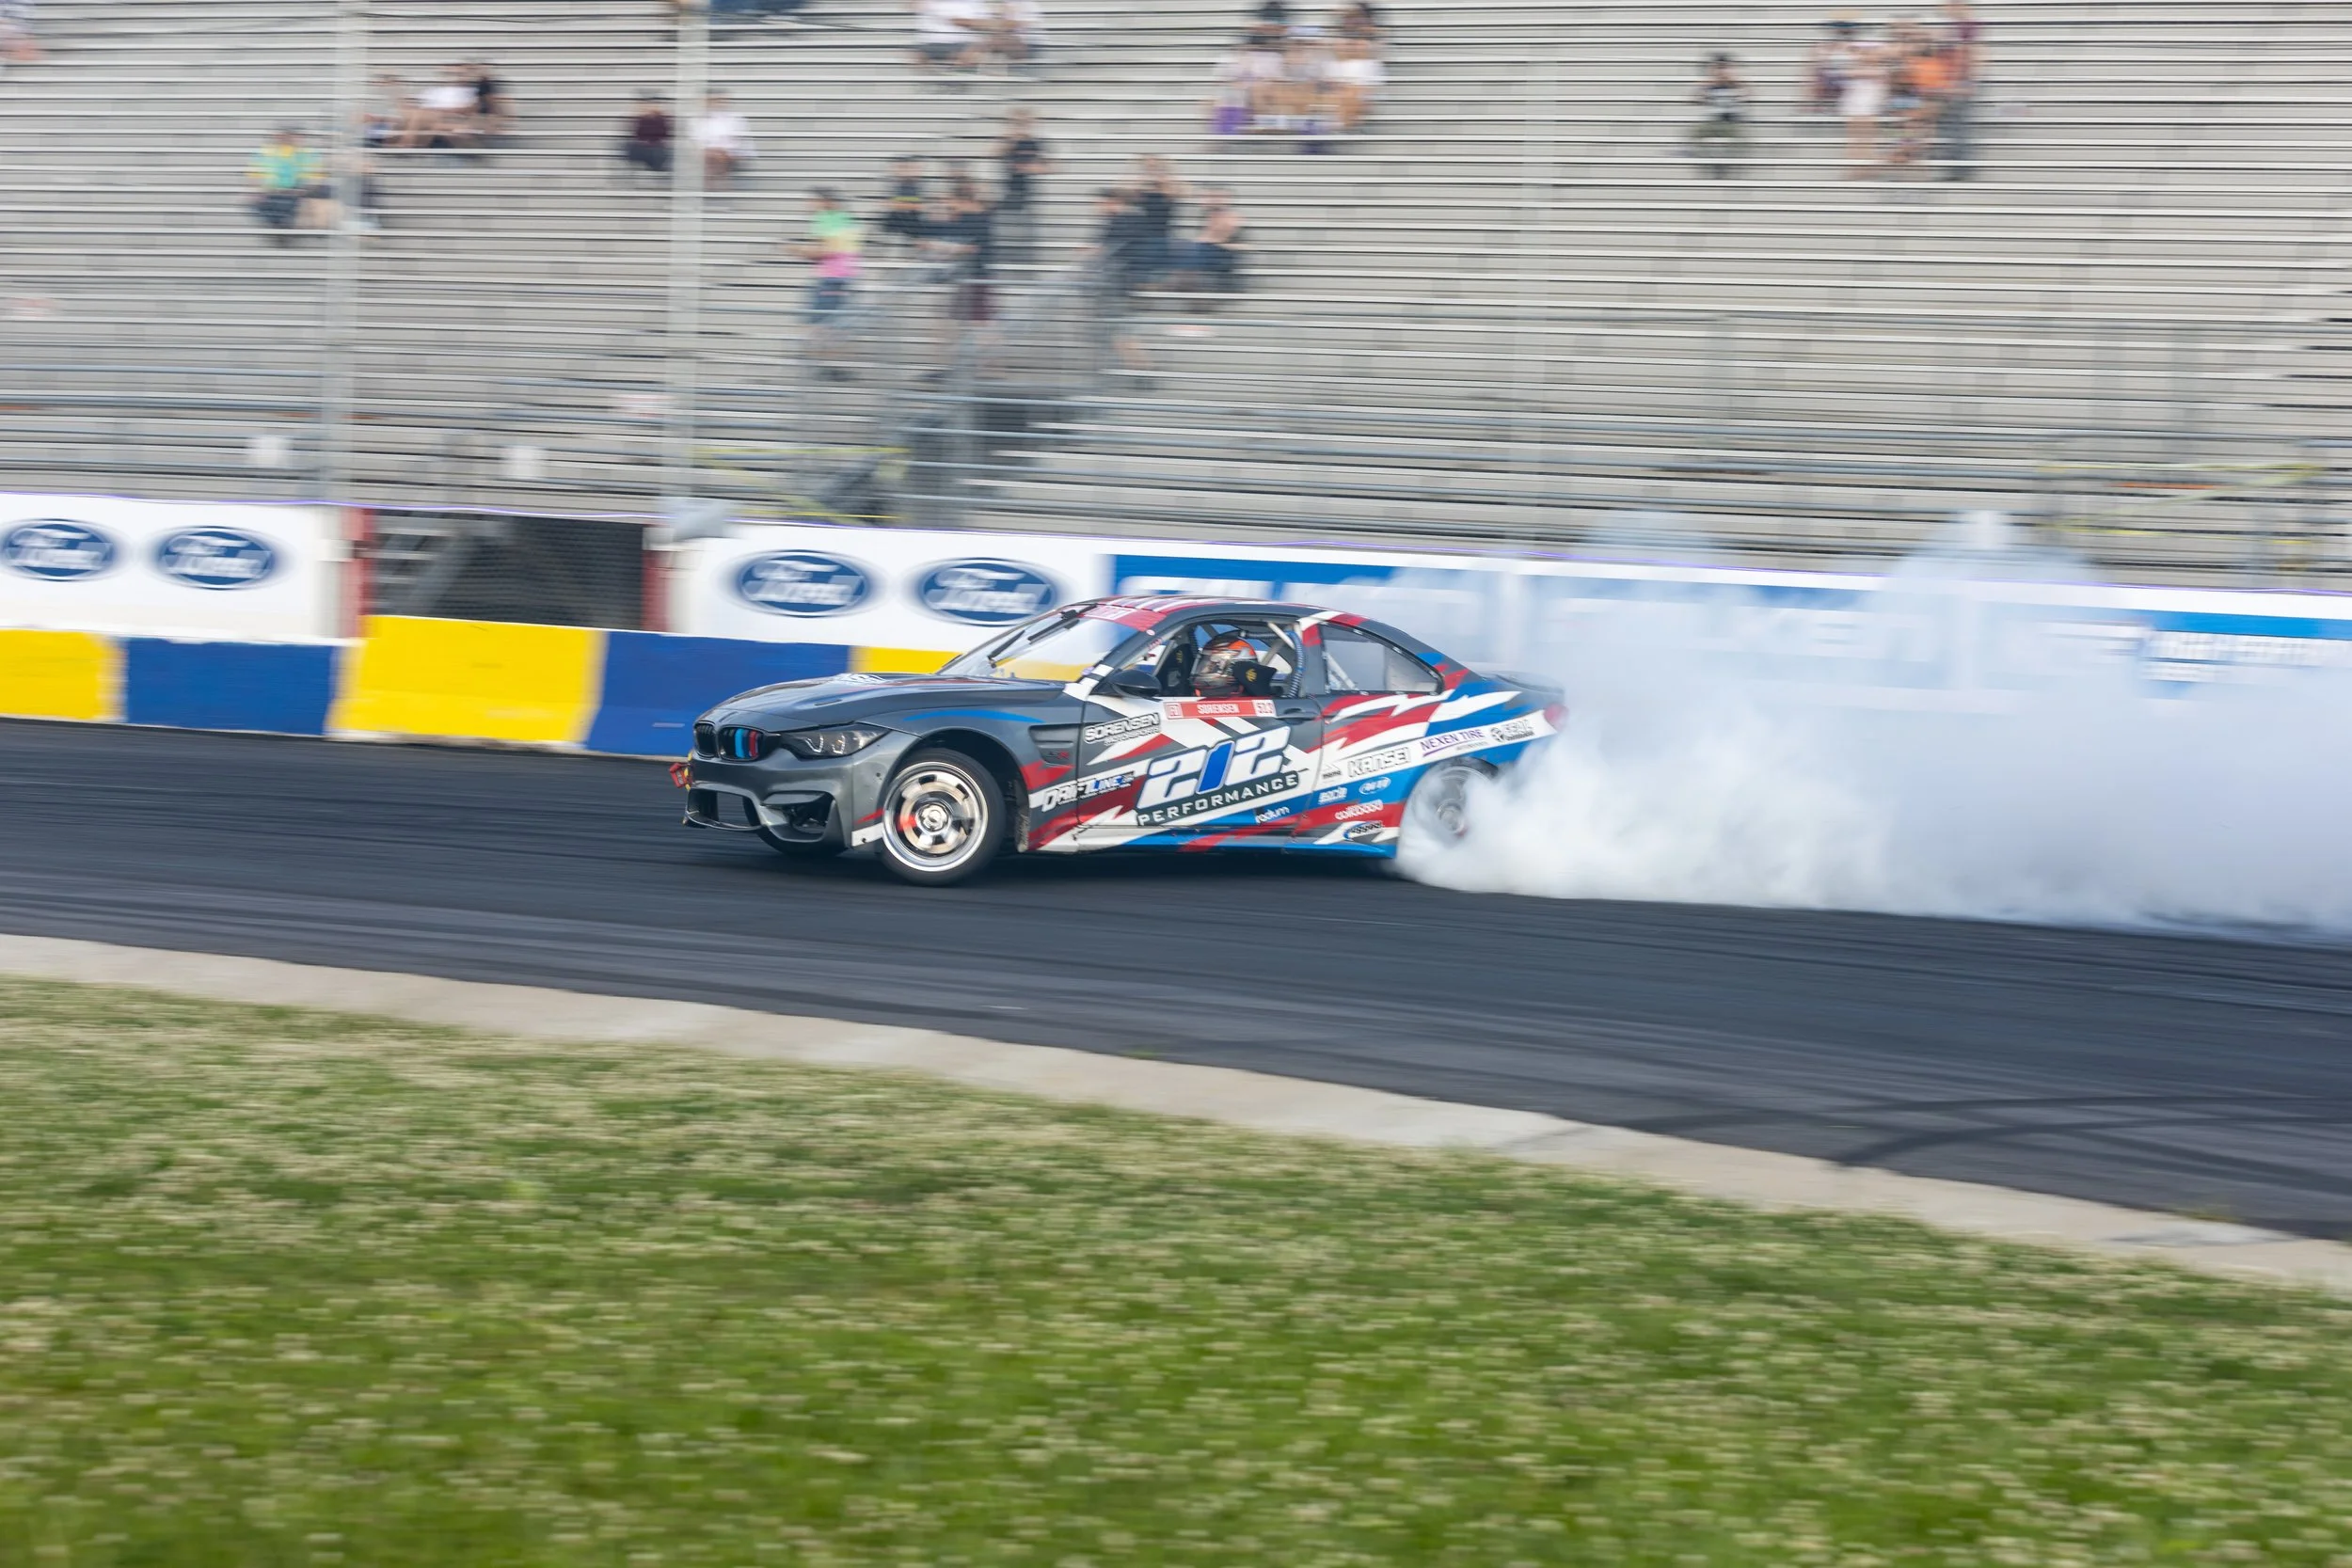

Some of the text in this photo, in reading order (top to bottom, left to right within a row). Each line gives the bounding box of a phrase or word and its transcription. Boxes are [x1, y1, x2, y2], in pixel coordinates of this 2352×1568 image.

[1085, 713, 1160, 742] SORENSEN
[1420, 734, 1458, 752] NEXEN
[1459, 728, 1486, 741] TIRE
[1136, 726, 1291, 809] 212
[1137, 774, 1298, 826] PERFORMANCE
